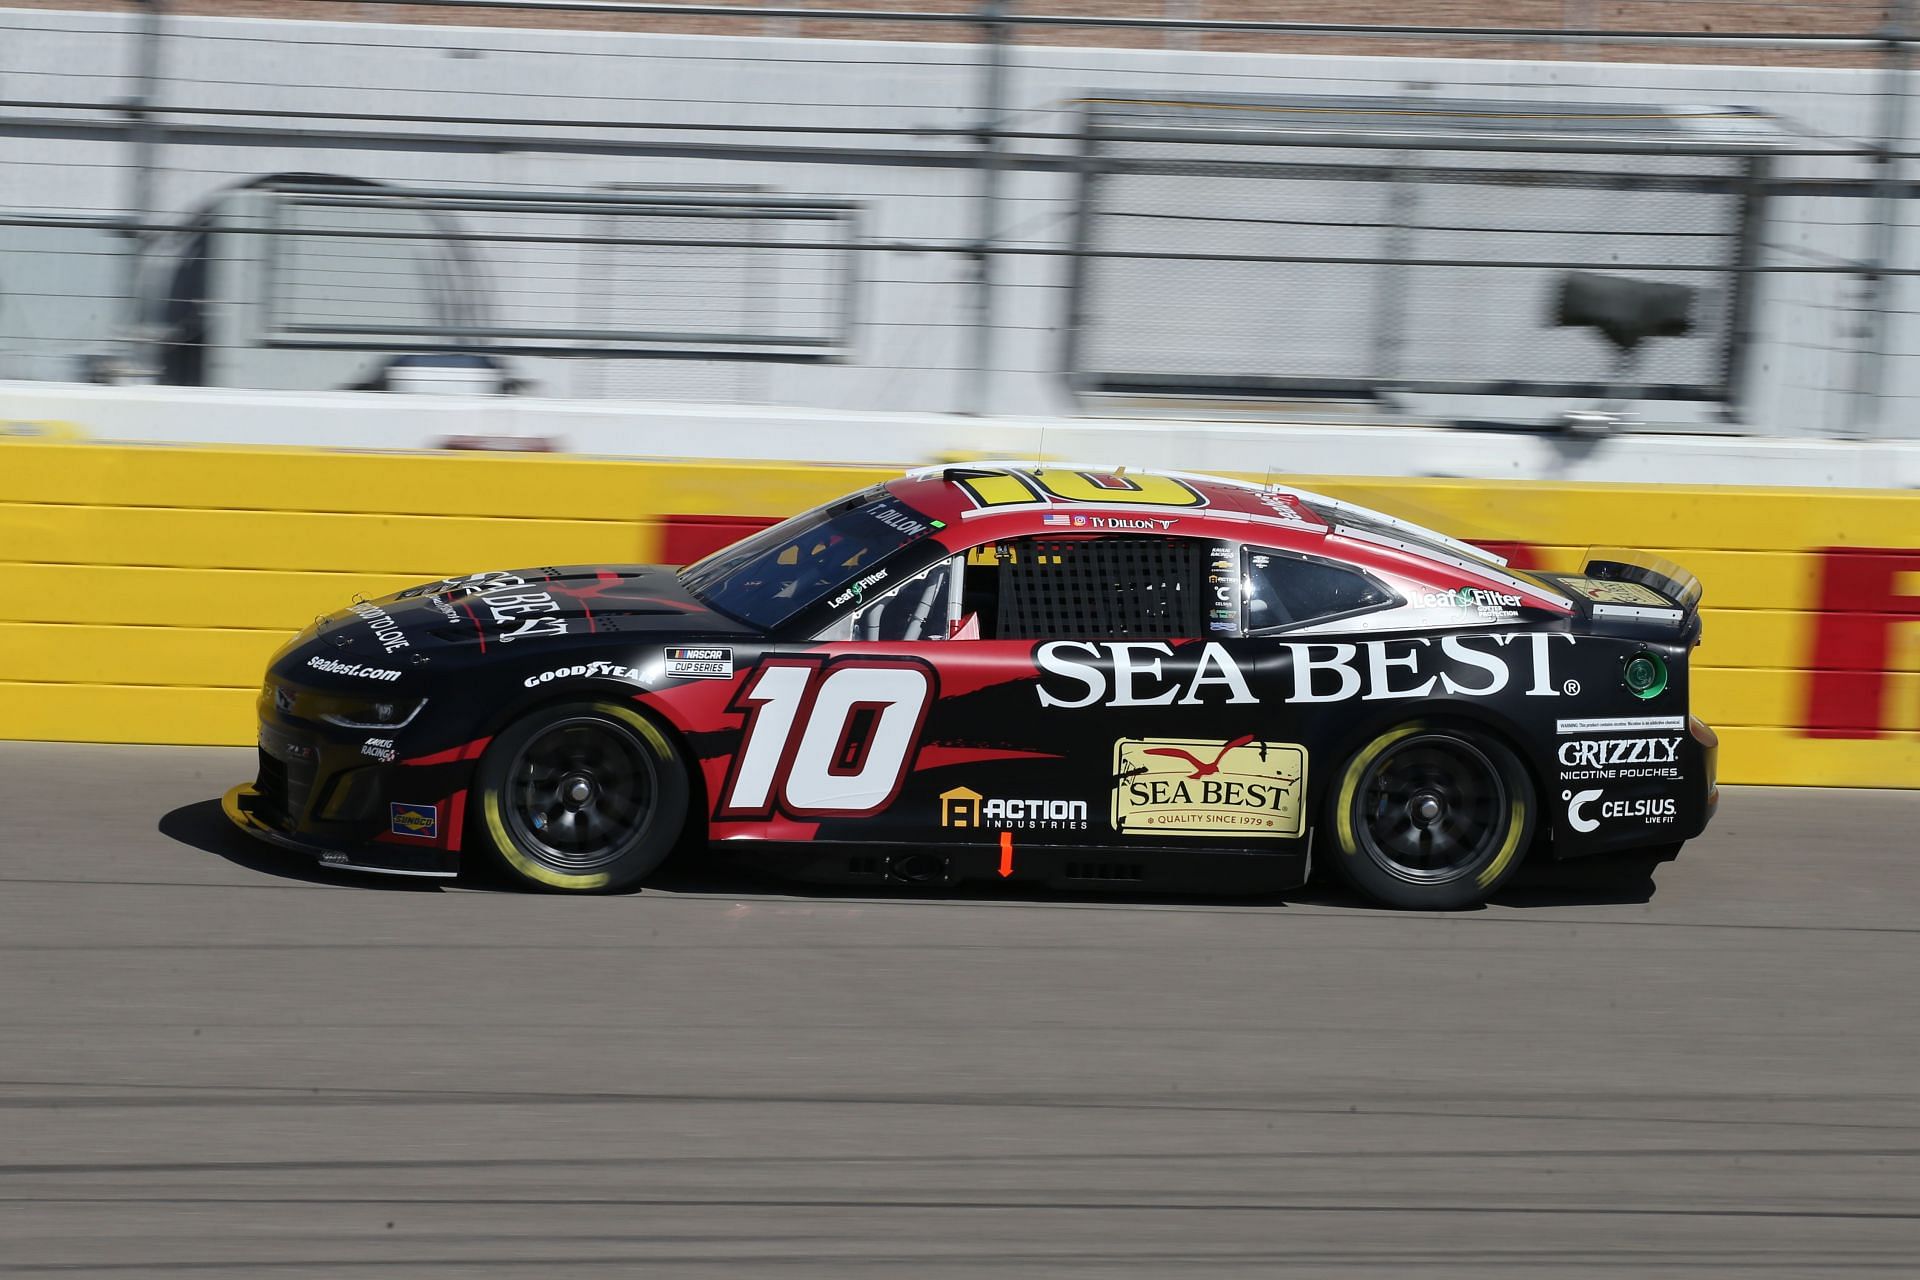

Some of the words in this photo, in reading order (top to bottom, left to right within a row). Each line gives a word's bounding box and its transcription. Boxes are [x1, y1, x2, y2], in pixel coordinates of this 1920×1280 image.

[875, 508, 928, 536] DILLON
[1090, 516, 1105, 528] TY
[1108, 517, 1155, 529] DILLON
[686, 650, 722, 660] NASCAR
[307, 656, 402, 681] seabest.com
[524, 661, 656, 688] GOODYEAR
[674, 663, 693, 672] CUP
[693, 663, 724, 673] SERIES
[1035, 640, 1260, 709] SEA
[724, 662, 932, 814] 10
[361, 745, 390, 759] RACING
[1558, 737, 1683, 769] GRIZZLY
[1560, 769, 1617, 780] NICOTINE
[1619, 767, 1678, 777] POUCHES
[1129, 780, 1194, 806] SEA
[983, 799, 1088, 820] ACTION
[1601, 798, 1676, 818] CELSIUS
[394, 814, 434, 828] SUNOCO
[986, 820, 1088, 829] INDUSTRIES
[1157, 815, 1204, 824] QUALITY
[1206, 814, 1237, 823] SINCE
[1239, 816, 1263, 826] 1979
